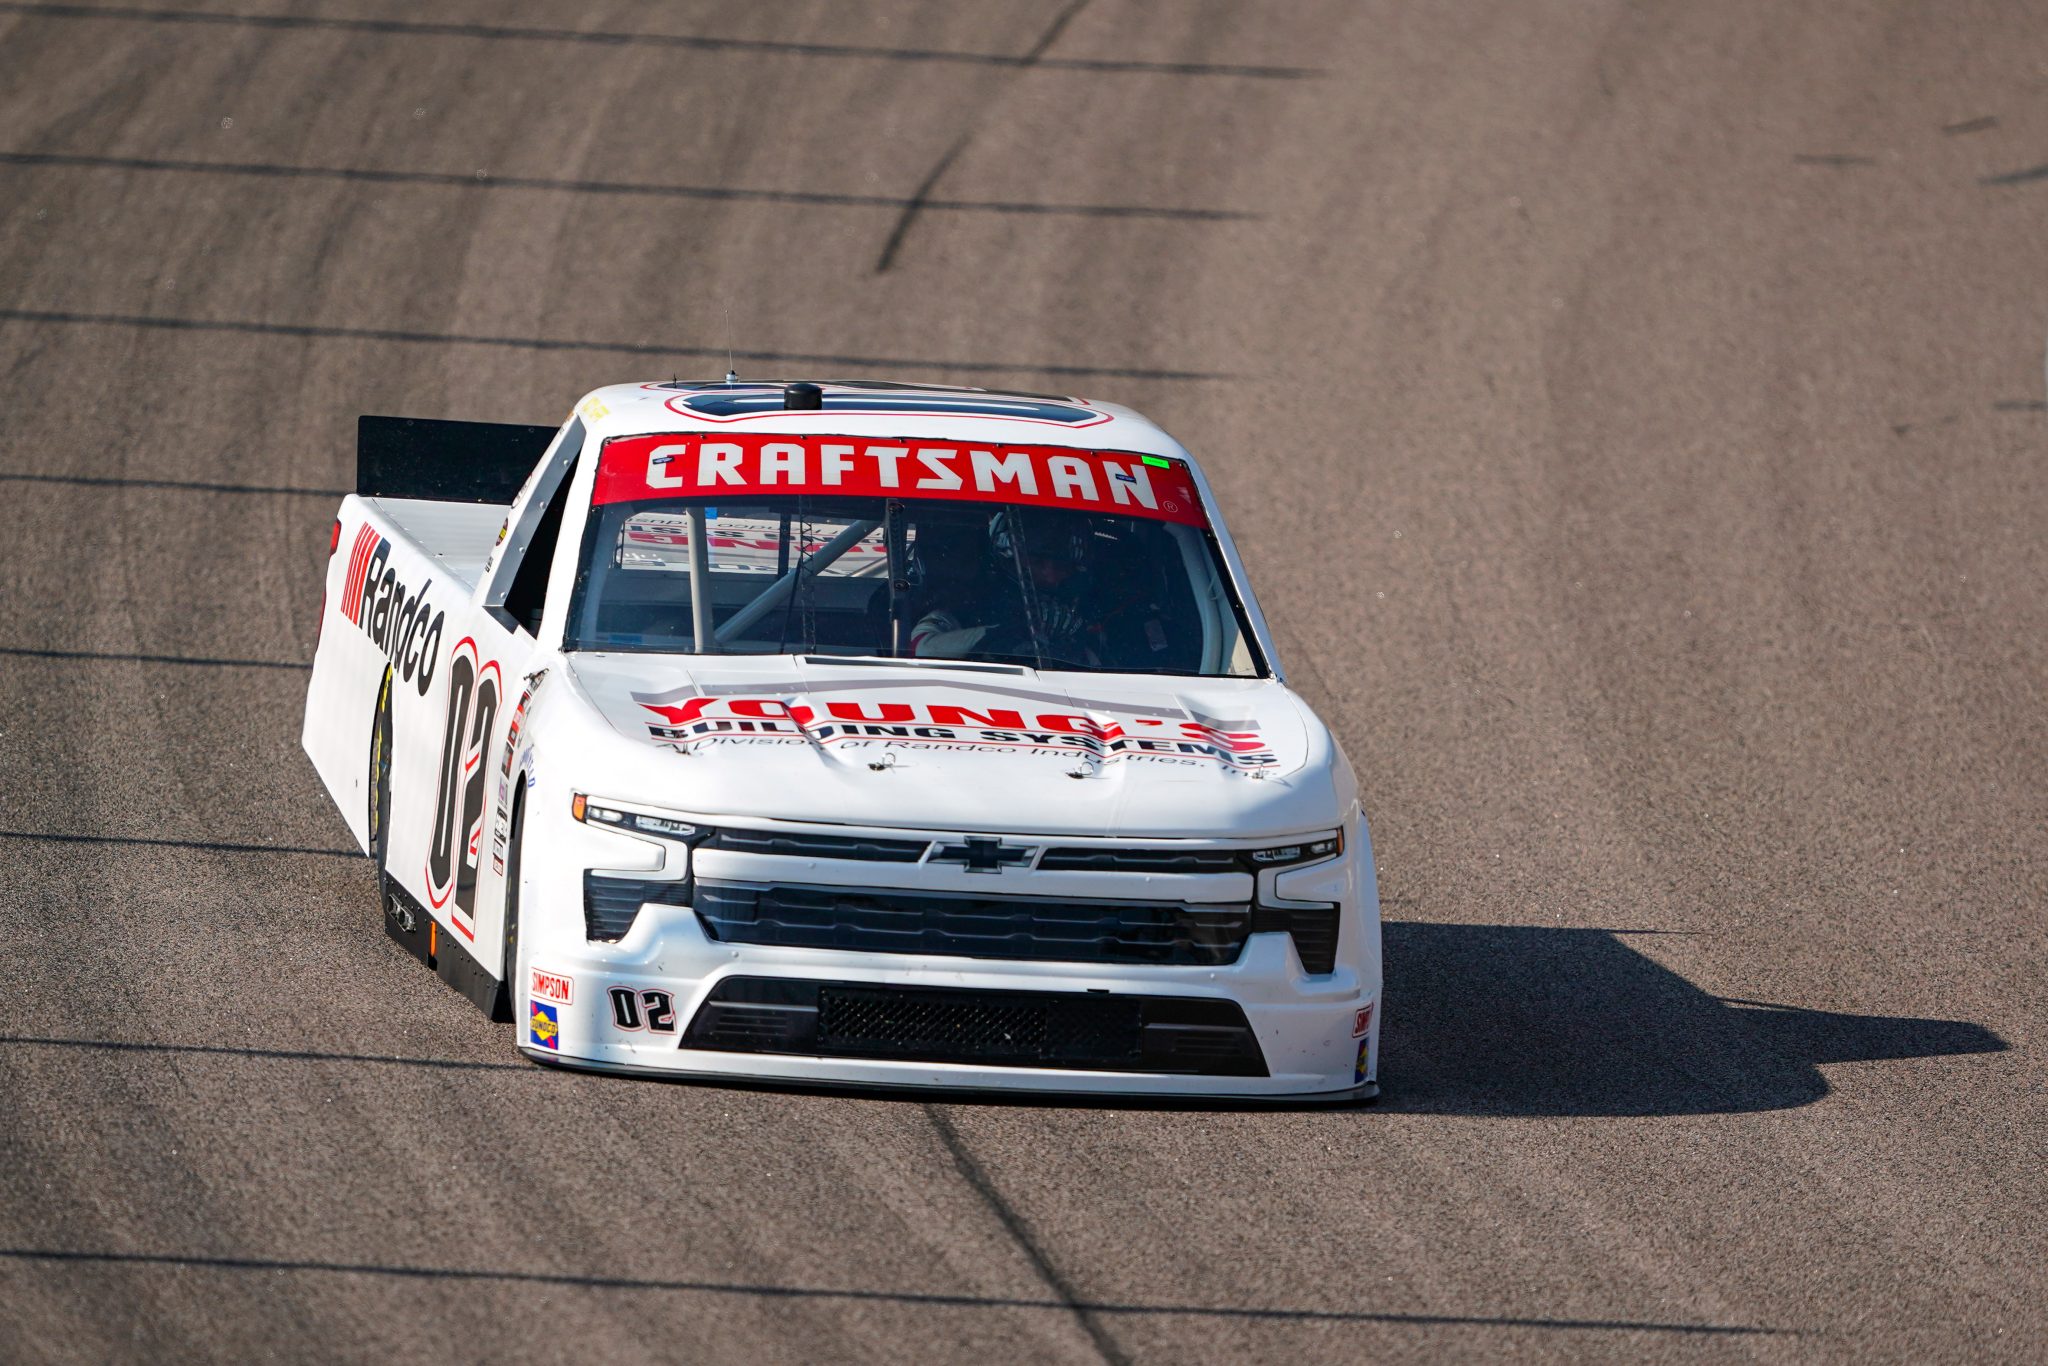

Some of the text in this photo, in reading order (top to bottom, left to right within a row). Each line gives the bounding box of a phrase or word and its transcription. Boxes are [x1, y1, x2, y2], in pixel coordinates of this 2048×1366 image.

[645, 442, 1159, 511] CRAFTSMAN
[358, 536, 445, 697] Randco
[638, 698, 1266, 751] YOUNG'S
[648, 720, 1278, 765] BUILDING SYSTEMS
[839, 740, 873, 750] of
[885, 740, 1016, 754] Randco
[427, 642, 501, 934] 02
[531, 971, 570, 1000] SIMPSON
[608, 986, 676, 1032] 02
